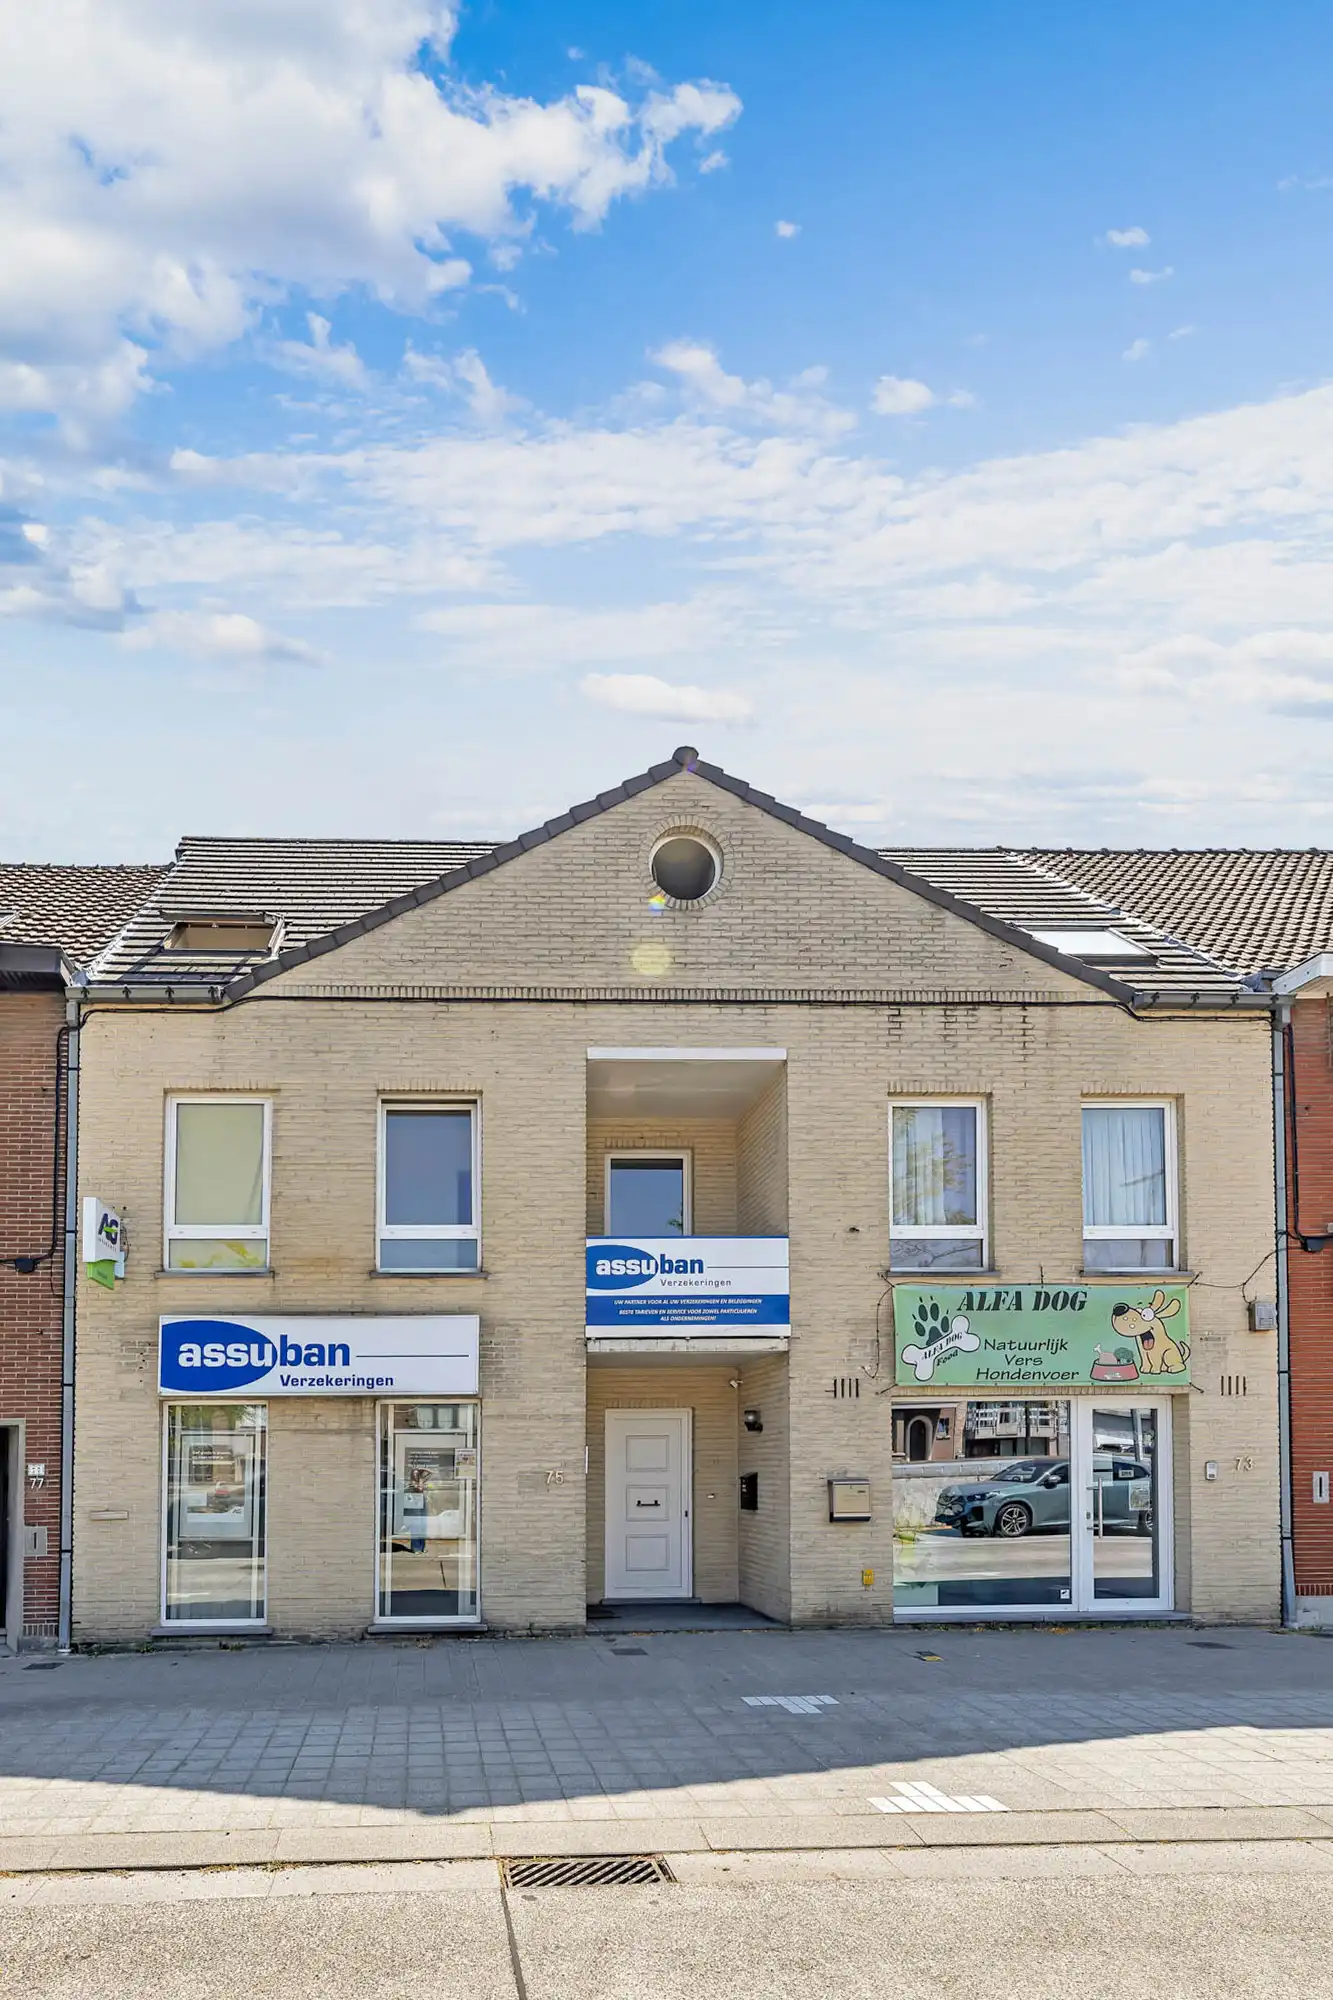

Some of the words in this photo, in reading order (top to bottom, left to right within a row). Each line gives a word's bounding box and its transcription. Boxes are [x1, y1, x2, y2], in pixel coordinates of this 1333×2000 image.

[98, 1212, 119, 1245] AG
[595, 1253, 704, 1276] assuban
[660, 1278, 732, 1288] Verzekeringen
[957, 1290, 1023, 1312] ALFA
[1032, 1290, 1088, 1312] DOG
[178, 1334, 351, 1368] assuban
[984, 1338, 1069, 1355] Natuurlijk
[936, 1349, 959, 1367] Food
[1004, 1353, 1043, 1366] Vers
[279, 1373, 394, 1389] Verzekeringen
[976, 1367, 1080, 1381] Hondenvoer
[1235, 1456, 1253, 1471] 73
[29, 1477, 44, 1489] 77
[544, 1470, 564, 1485] 75
